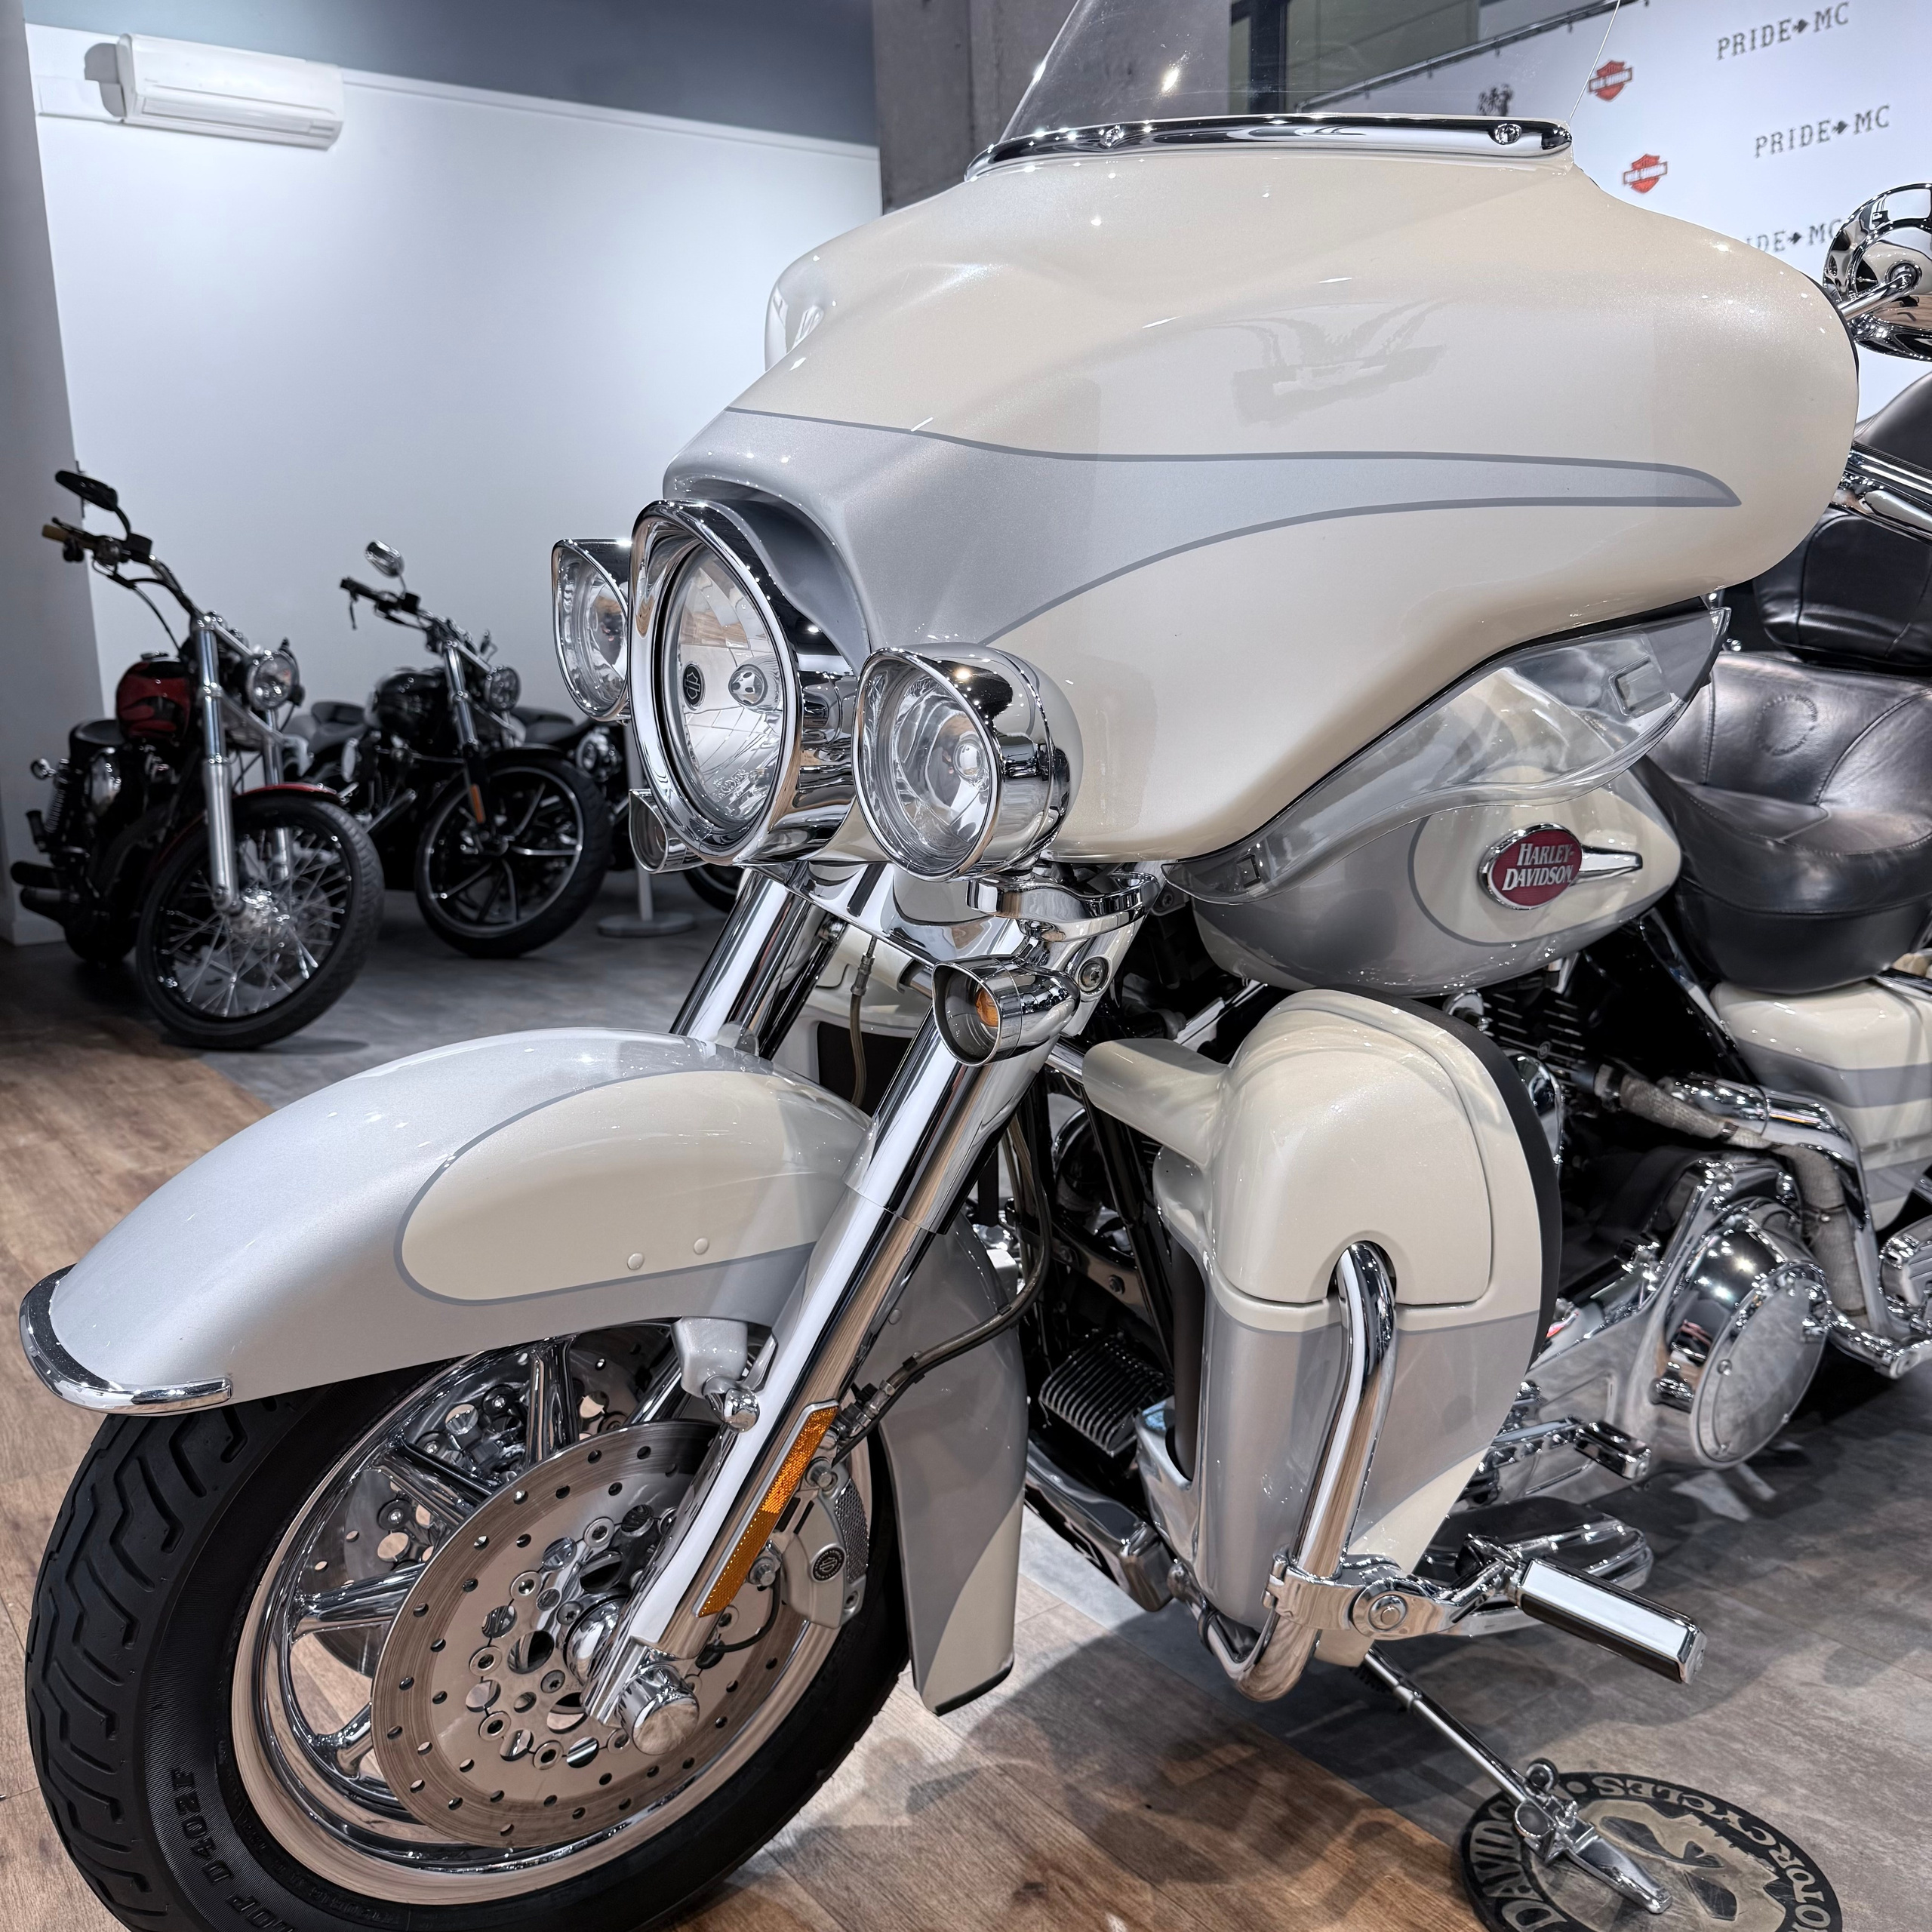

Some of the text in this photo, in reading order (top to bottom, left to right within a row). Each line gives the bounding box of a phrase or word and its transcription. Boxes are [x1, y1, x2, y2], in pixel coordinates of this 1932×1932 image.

[1717, 2, 1850, 61] PRIDE MC
[1755, 104, 1890, 158] PRIDE MC
[1592, 1776, 1831, 1932] OTORCYCLES
